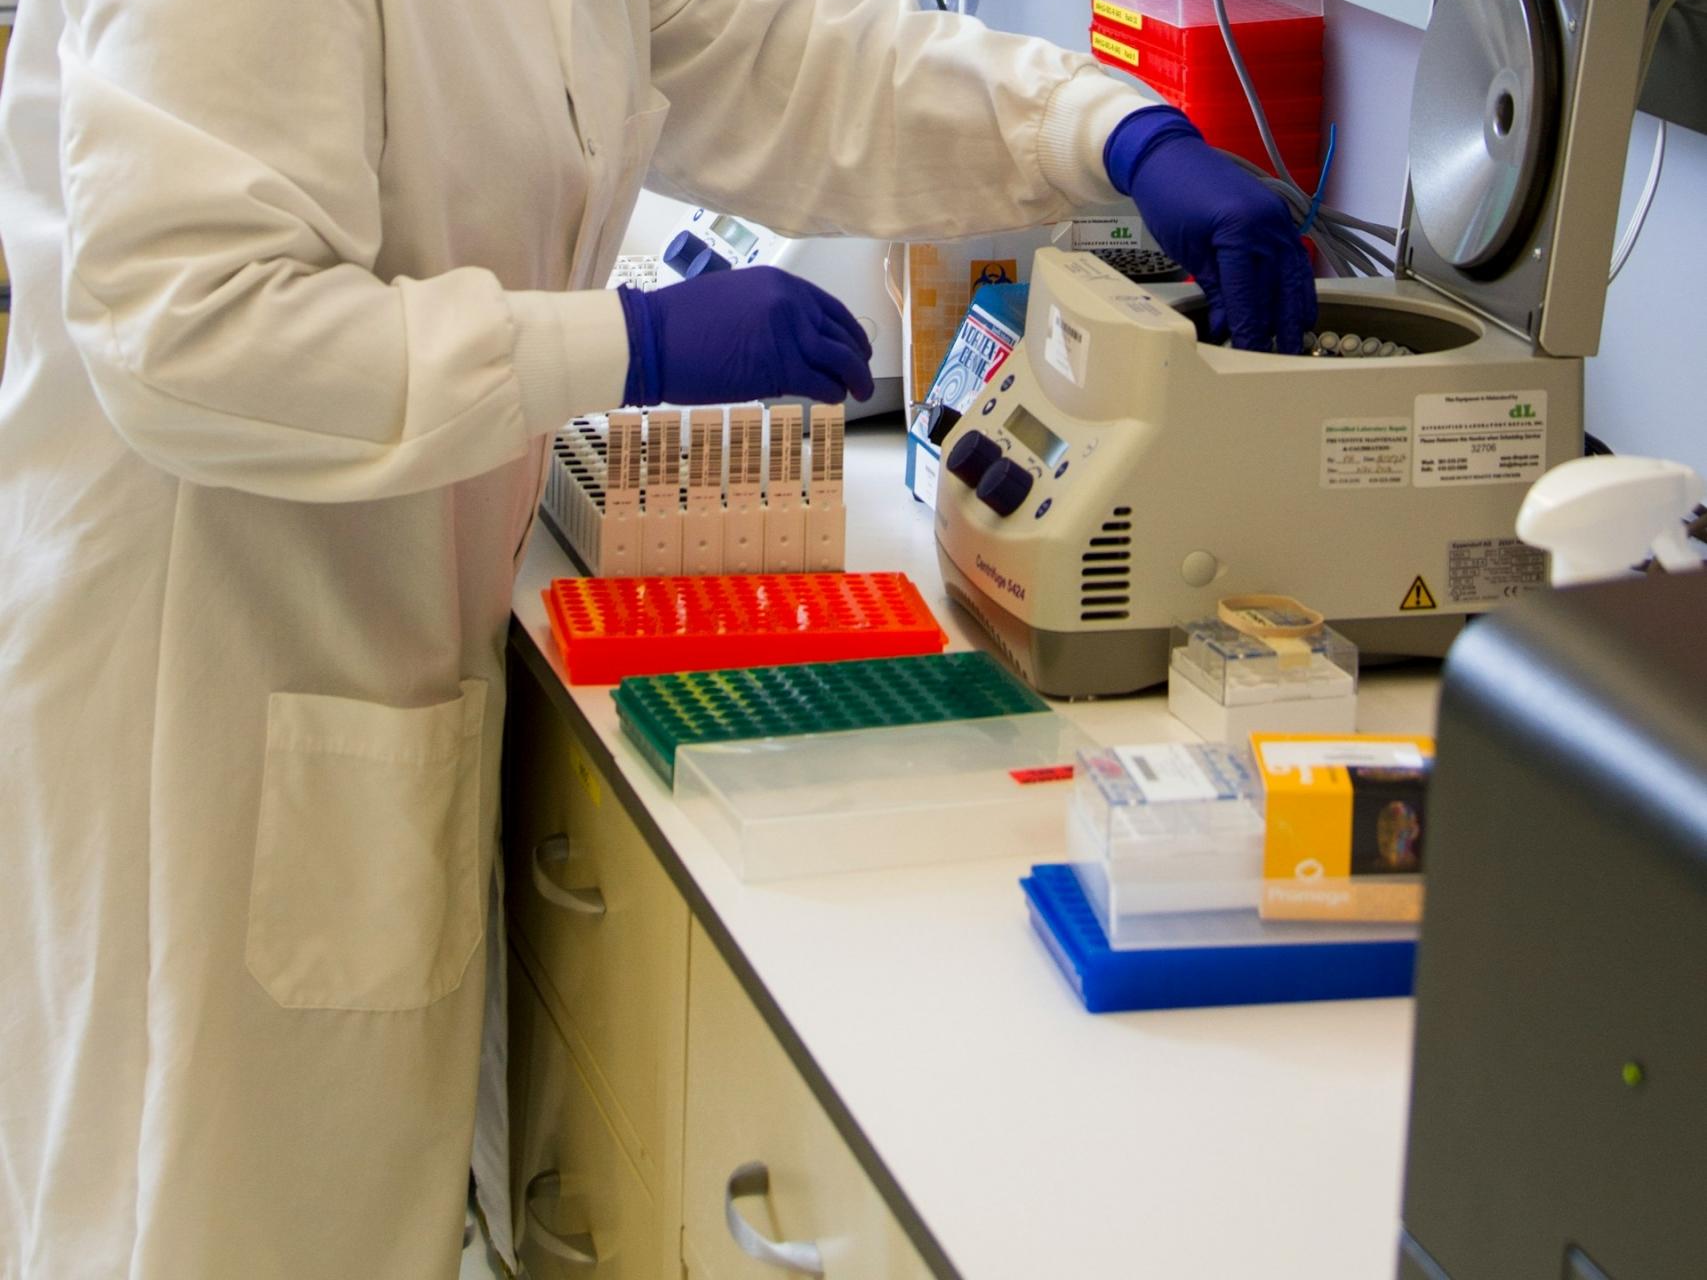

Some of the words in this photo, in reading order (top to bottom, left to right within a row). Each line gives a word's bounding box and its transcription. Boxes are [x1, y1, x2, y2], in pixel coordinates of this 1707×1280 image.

[961, 321, 997, 361] VORTEX
[959, 345, 988, 380] GENIE
[1509, 404, 1536, 418] dL
[976, 553, 1007, 591] Centrifuge
